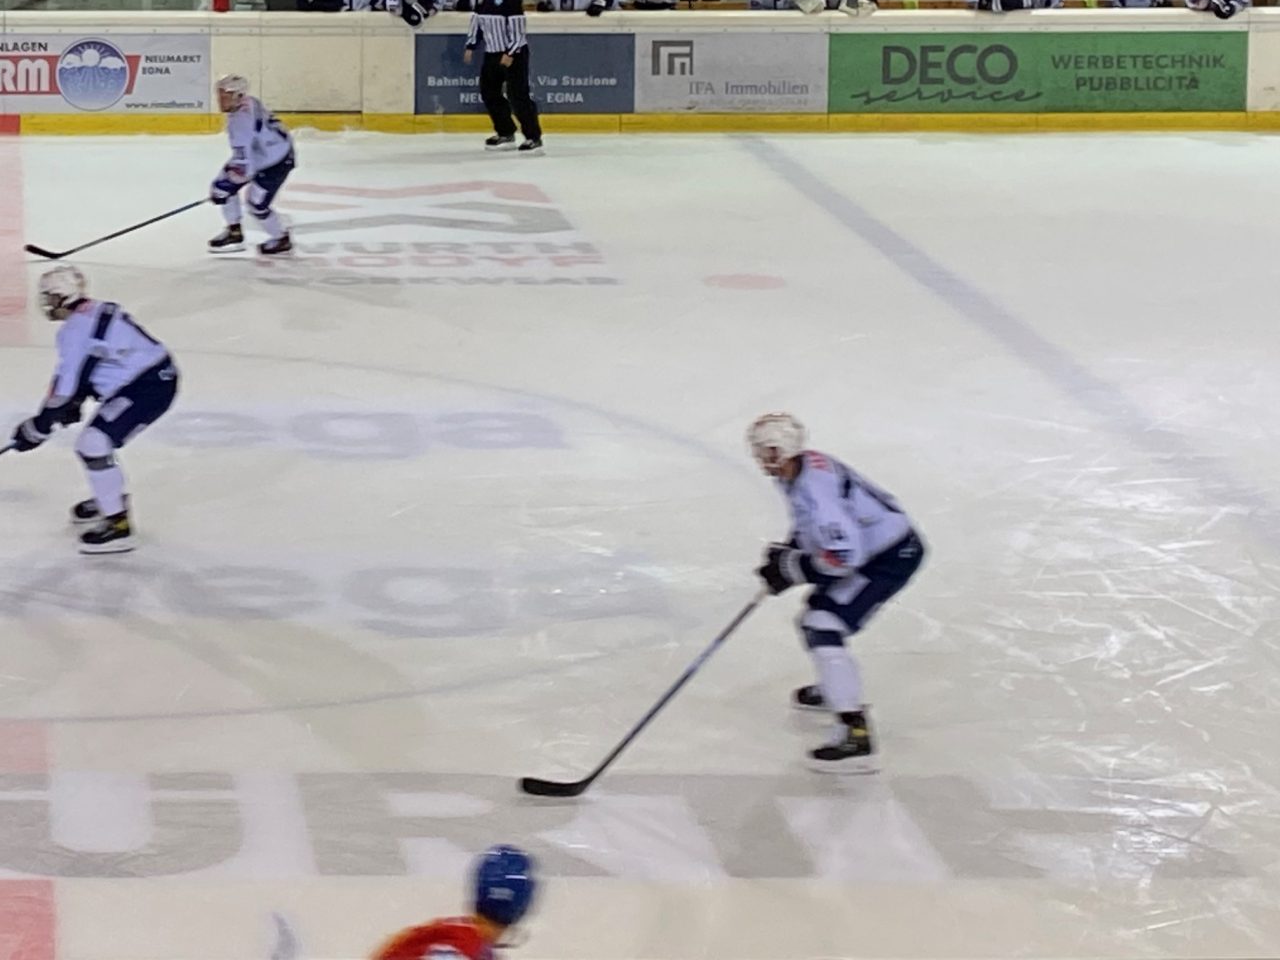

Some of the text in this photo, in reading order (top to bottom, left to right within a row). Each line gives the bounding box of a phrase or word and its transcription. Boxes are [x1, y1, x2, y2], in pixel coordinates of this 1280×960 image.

[145, 55, 201, 63] NEUMARKT
[881, 44, 1018, 85] DECO
[1051, 54, 1226, 70] WERBETECHNIK
[142, 67, 171, 75] EGNA
[537, 76, 558, 86] Via
[562, 76, 617, 87] Stazione
[689, 80, 809, 95] IFA Immobilien
[1075, 74, 1200, 92] PUBBLICITÀ
[547, 93, 584, 103] EGNA
[851, 84, 1044, 105] service
